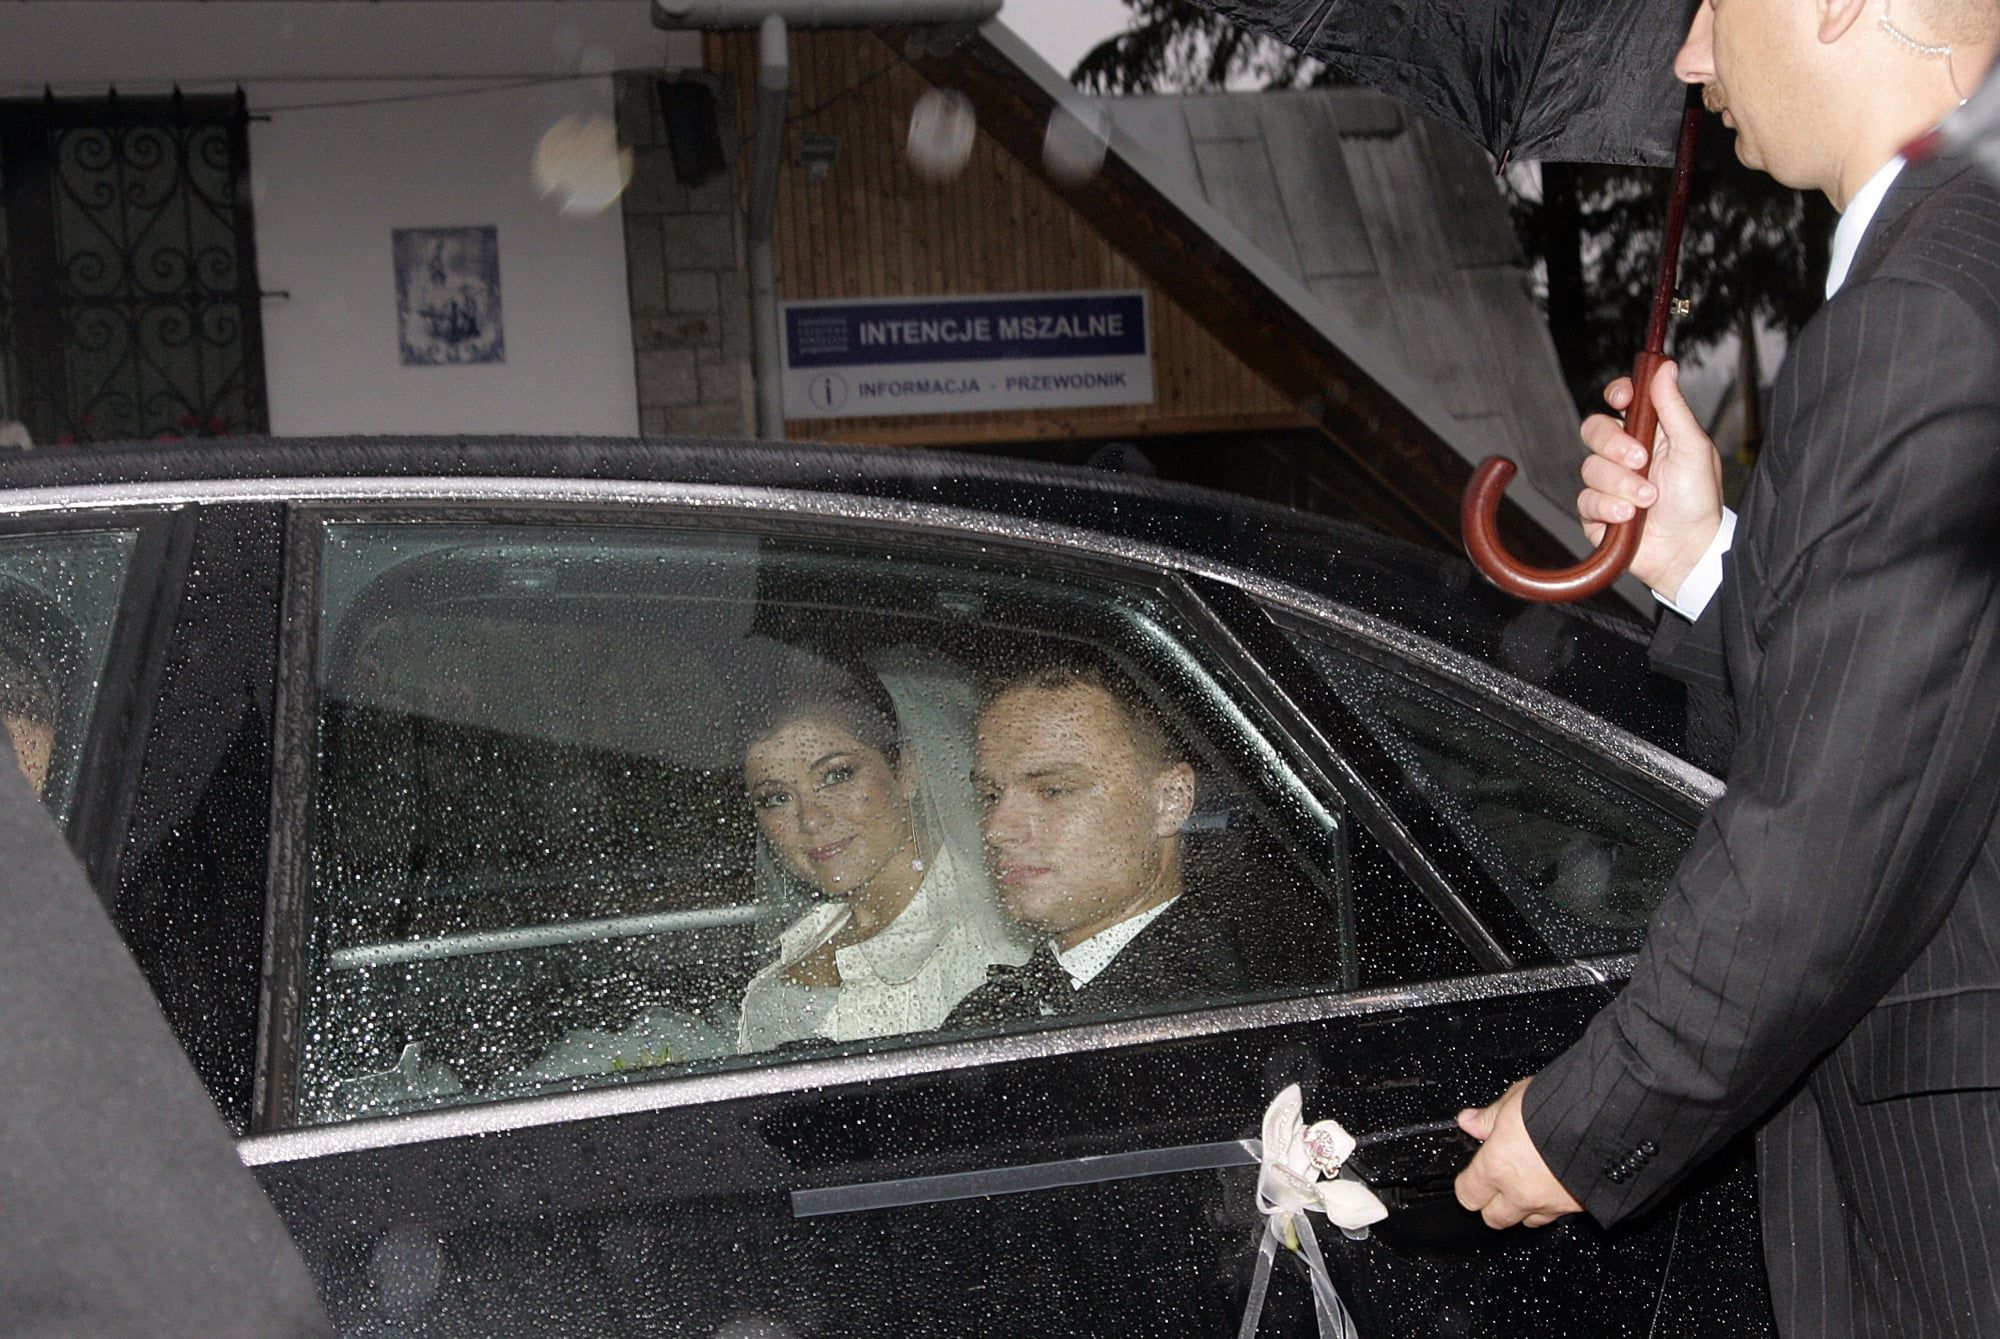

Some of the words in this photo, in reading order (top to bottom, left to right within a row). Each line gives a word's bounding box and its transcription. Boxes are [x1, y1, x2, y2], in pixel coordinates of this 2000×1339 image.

[858, 319, 992, 345] INTENCJE
[998, 314, 1125, 341] MSZALNE
[858, 377, 981, 398] INFORMACJA
[1005, 371, 1127, 392] PRZEWODNIK
